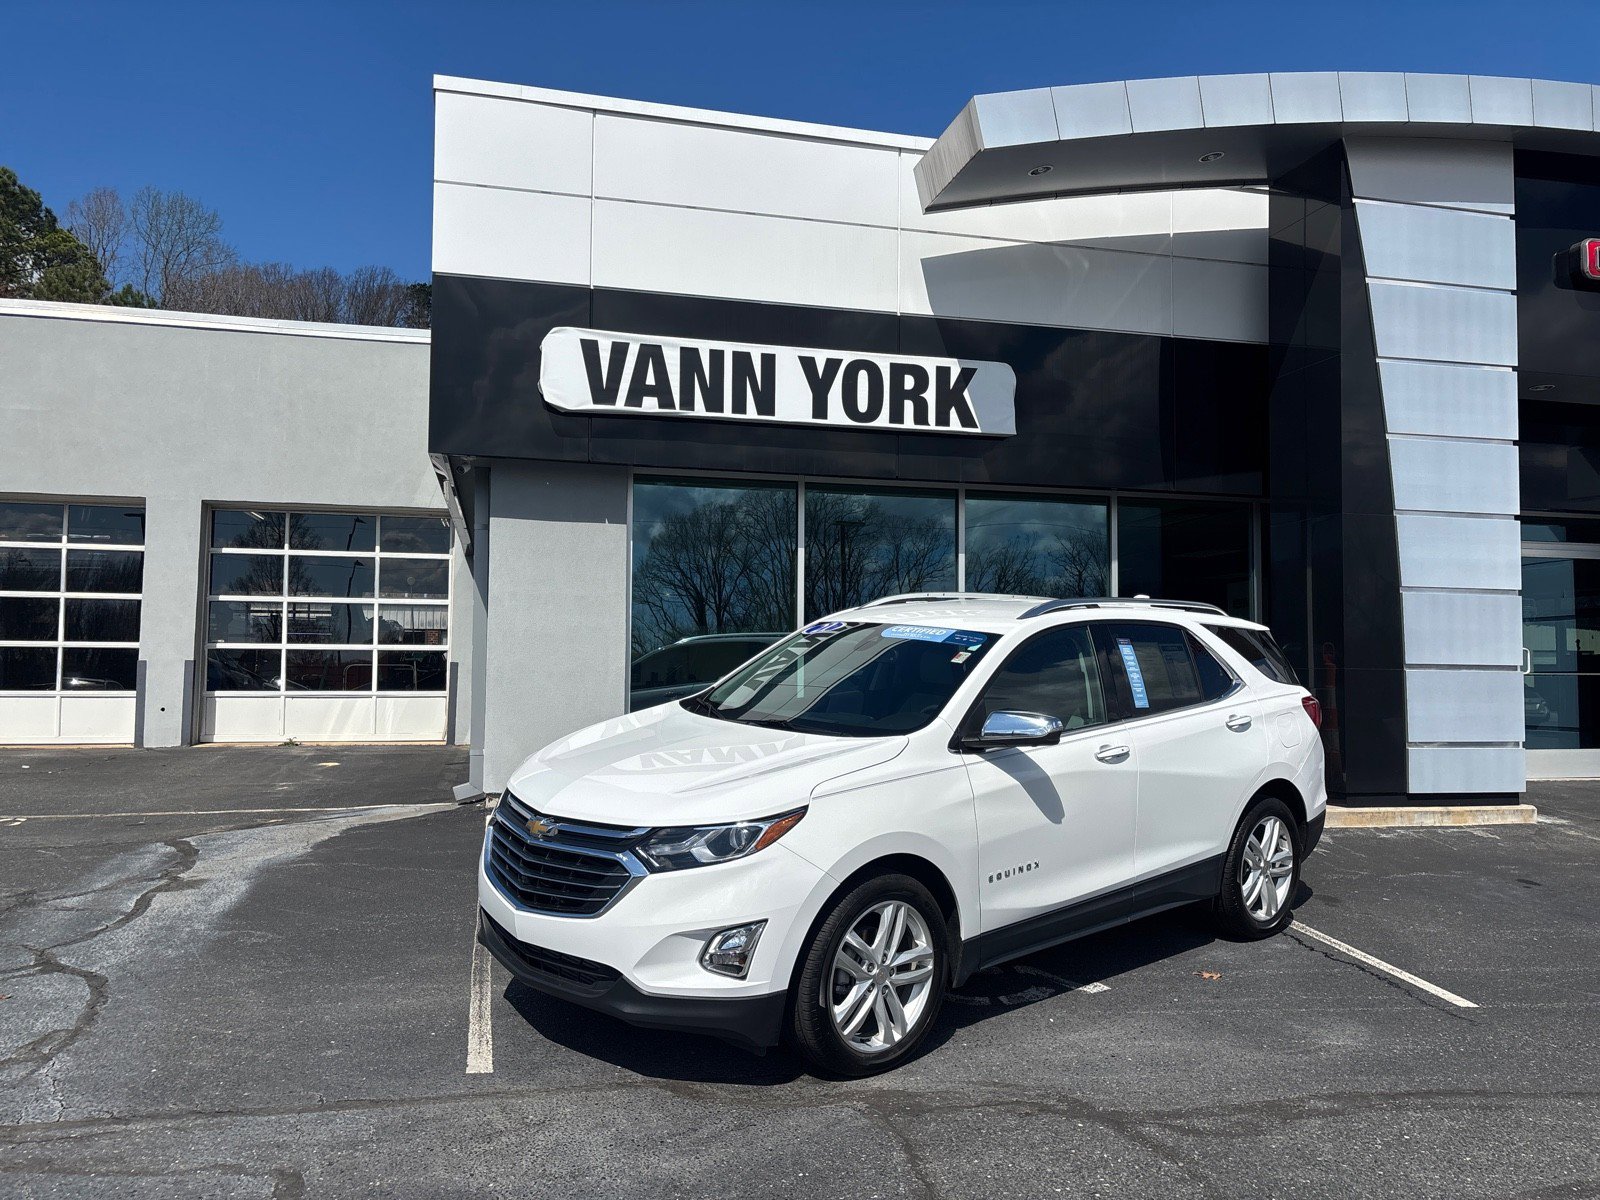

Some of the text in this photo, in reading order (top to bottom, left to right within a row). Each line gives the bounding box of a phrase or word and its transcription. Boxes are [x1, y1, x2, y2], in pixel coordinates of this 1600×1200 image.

[579, 338, 979, 429] VANN YORK
[890, 625, 947, 636] CERTIFIED
[988, 860, 1040, 884] EQUINOX
